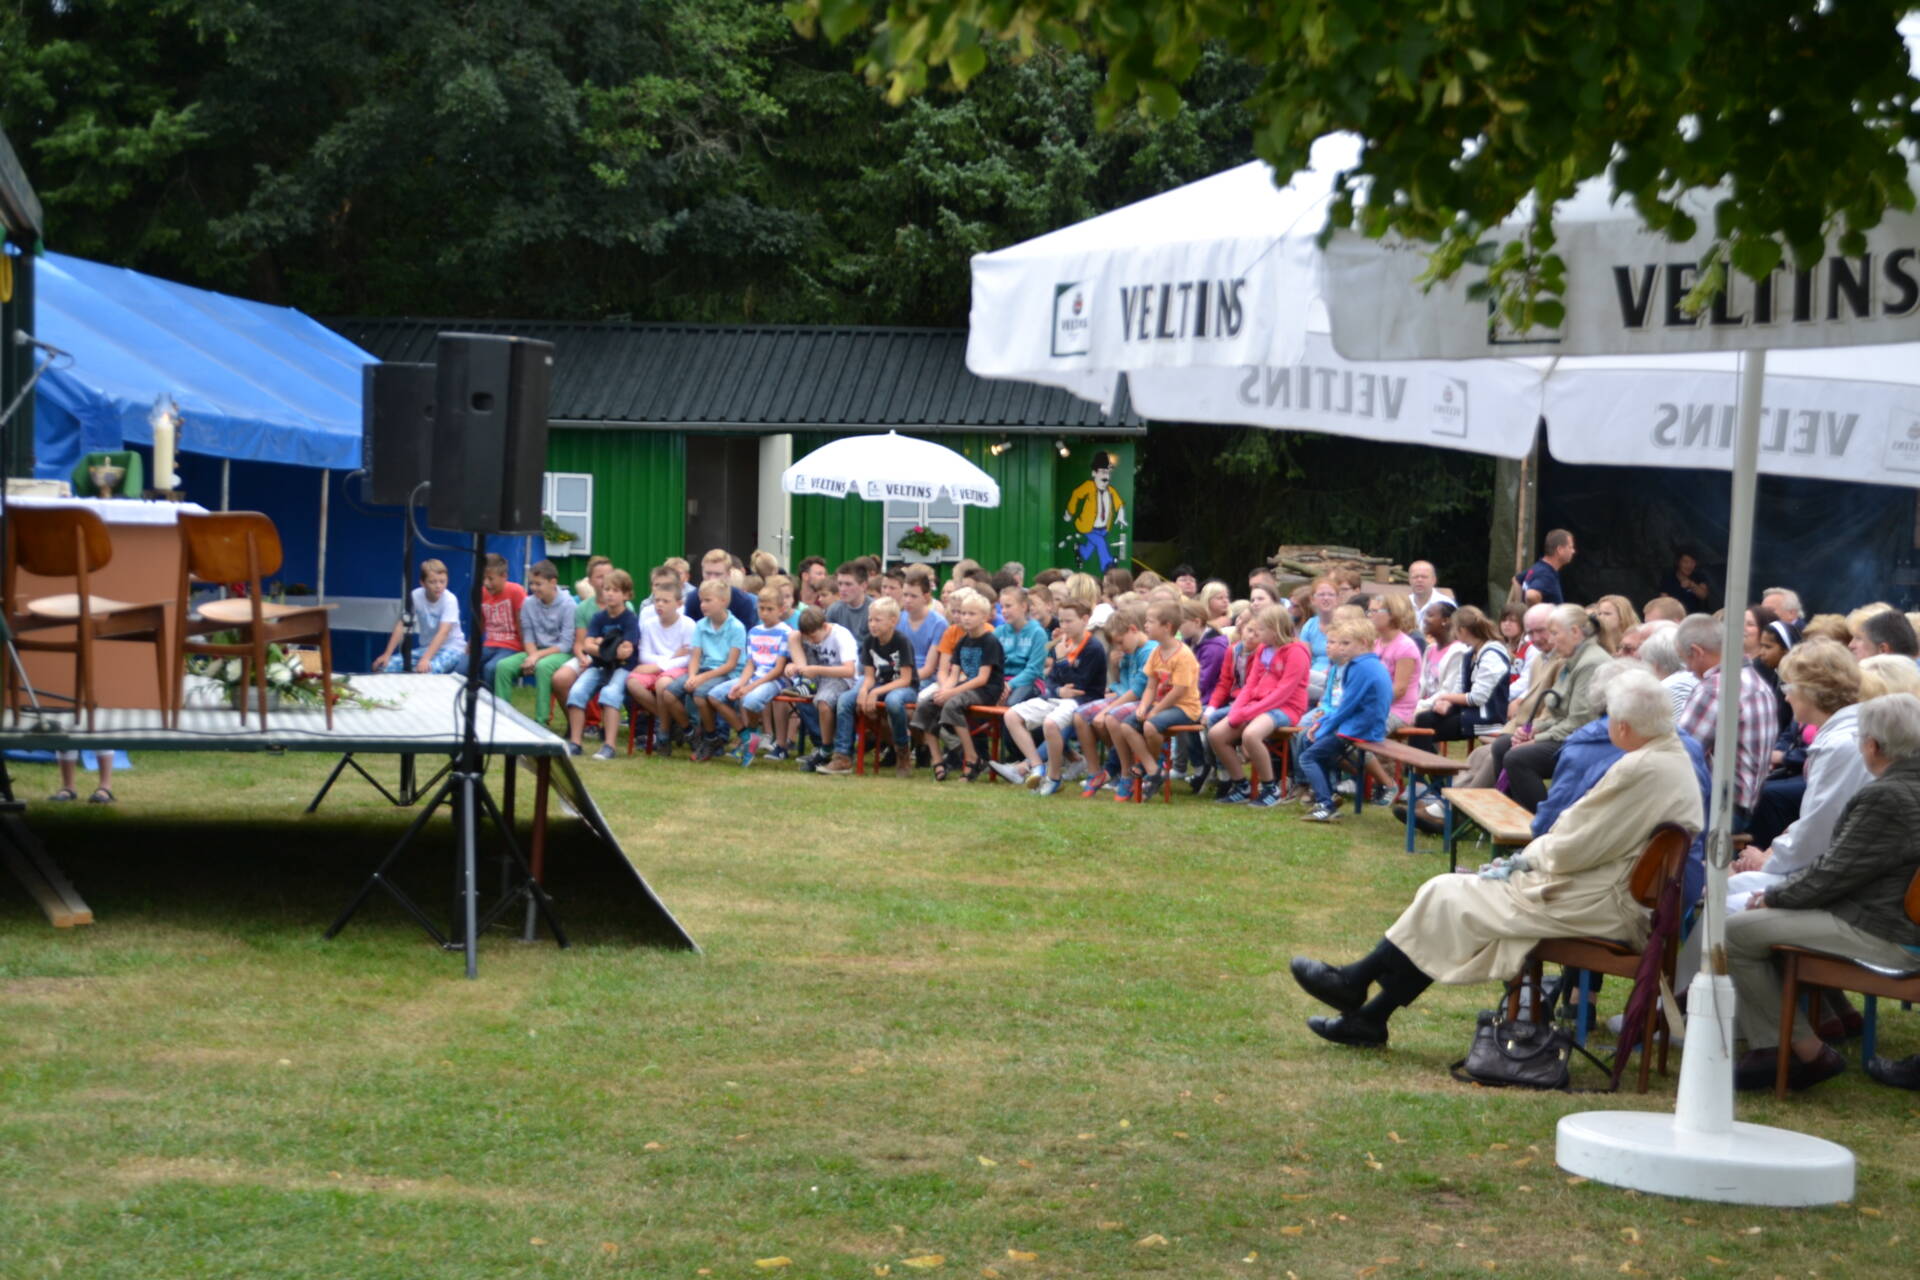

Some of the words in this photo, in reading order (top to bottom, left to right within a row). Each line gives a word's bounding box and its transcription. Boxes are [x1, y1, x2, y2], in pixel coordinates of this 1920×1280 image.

[1120, 278, 1246, 341] VELTINS
[811, 477, 846, 493] VELTINS
[885, 483, 932, 498] VELTINS
[959, 487, 989, 503] VETINS
